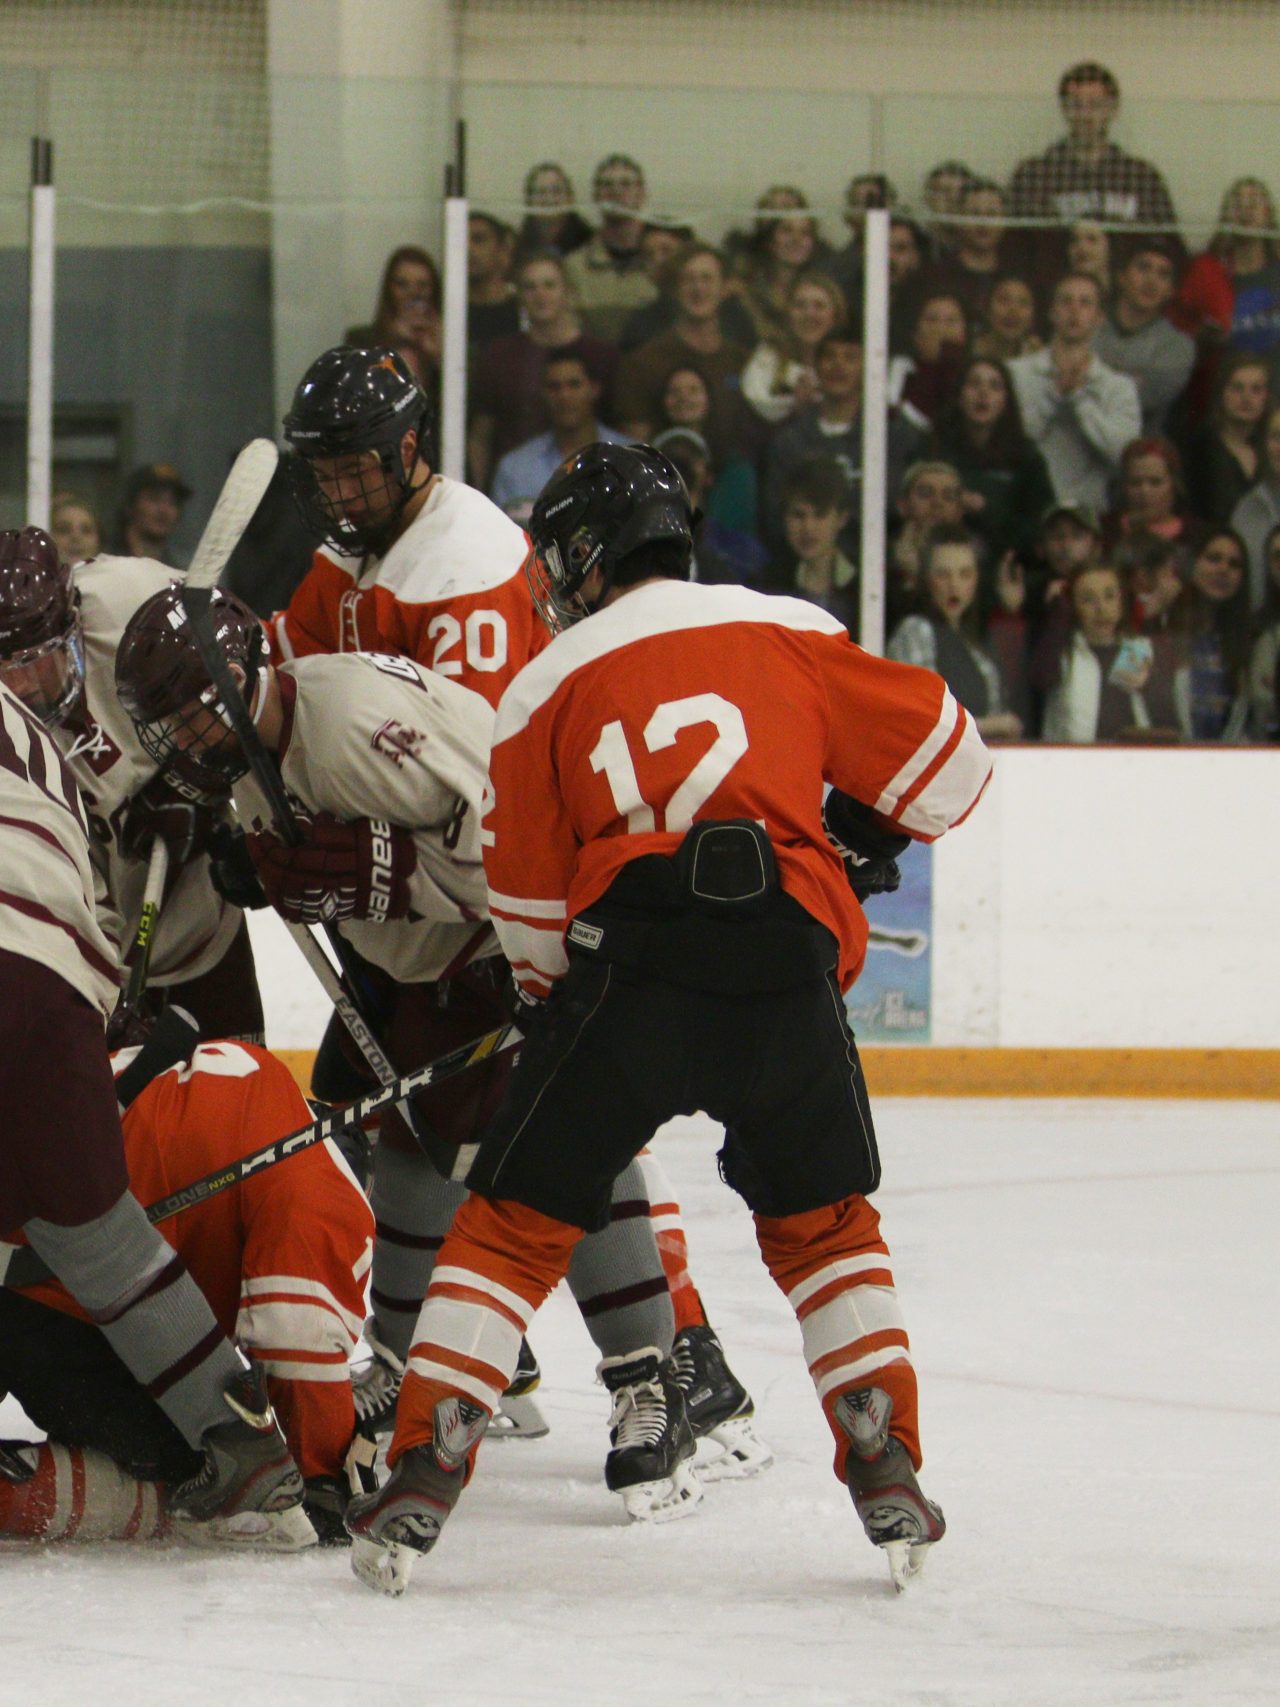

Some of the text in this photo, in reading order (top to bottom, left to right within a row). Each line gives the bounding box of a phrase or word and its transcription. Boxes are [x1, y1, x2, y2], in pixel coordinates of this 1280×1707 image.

[427, 609, 507, 677] 20
[588, 692, 749, 835] 12
[366, 819, 393, 924] BAUER
[136, 901, 153, 947] CCM
[572, 926, 598, 942] BAUER
[336, 997, 395, 1085] EASTON
